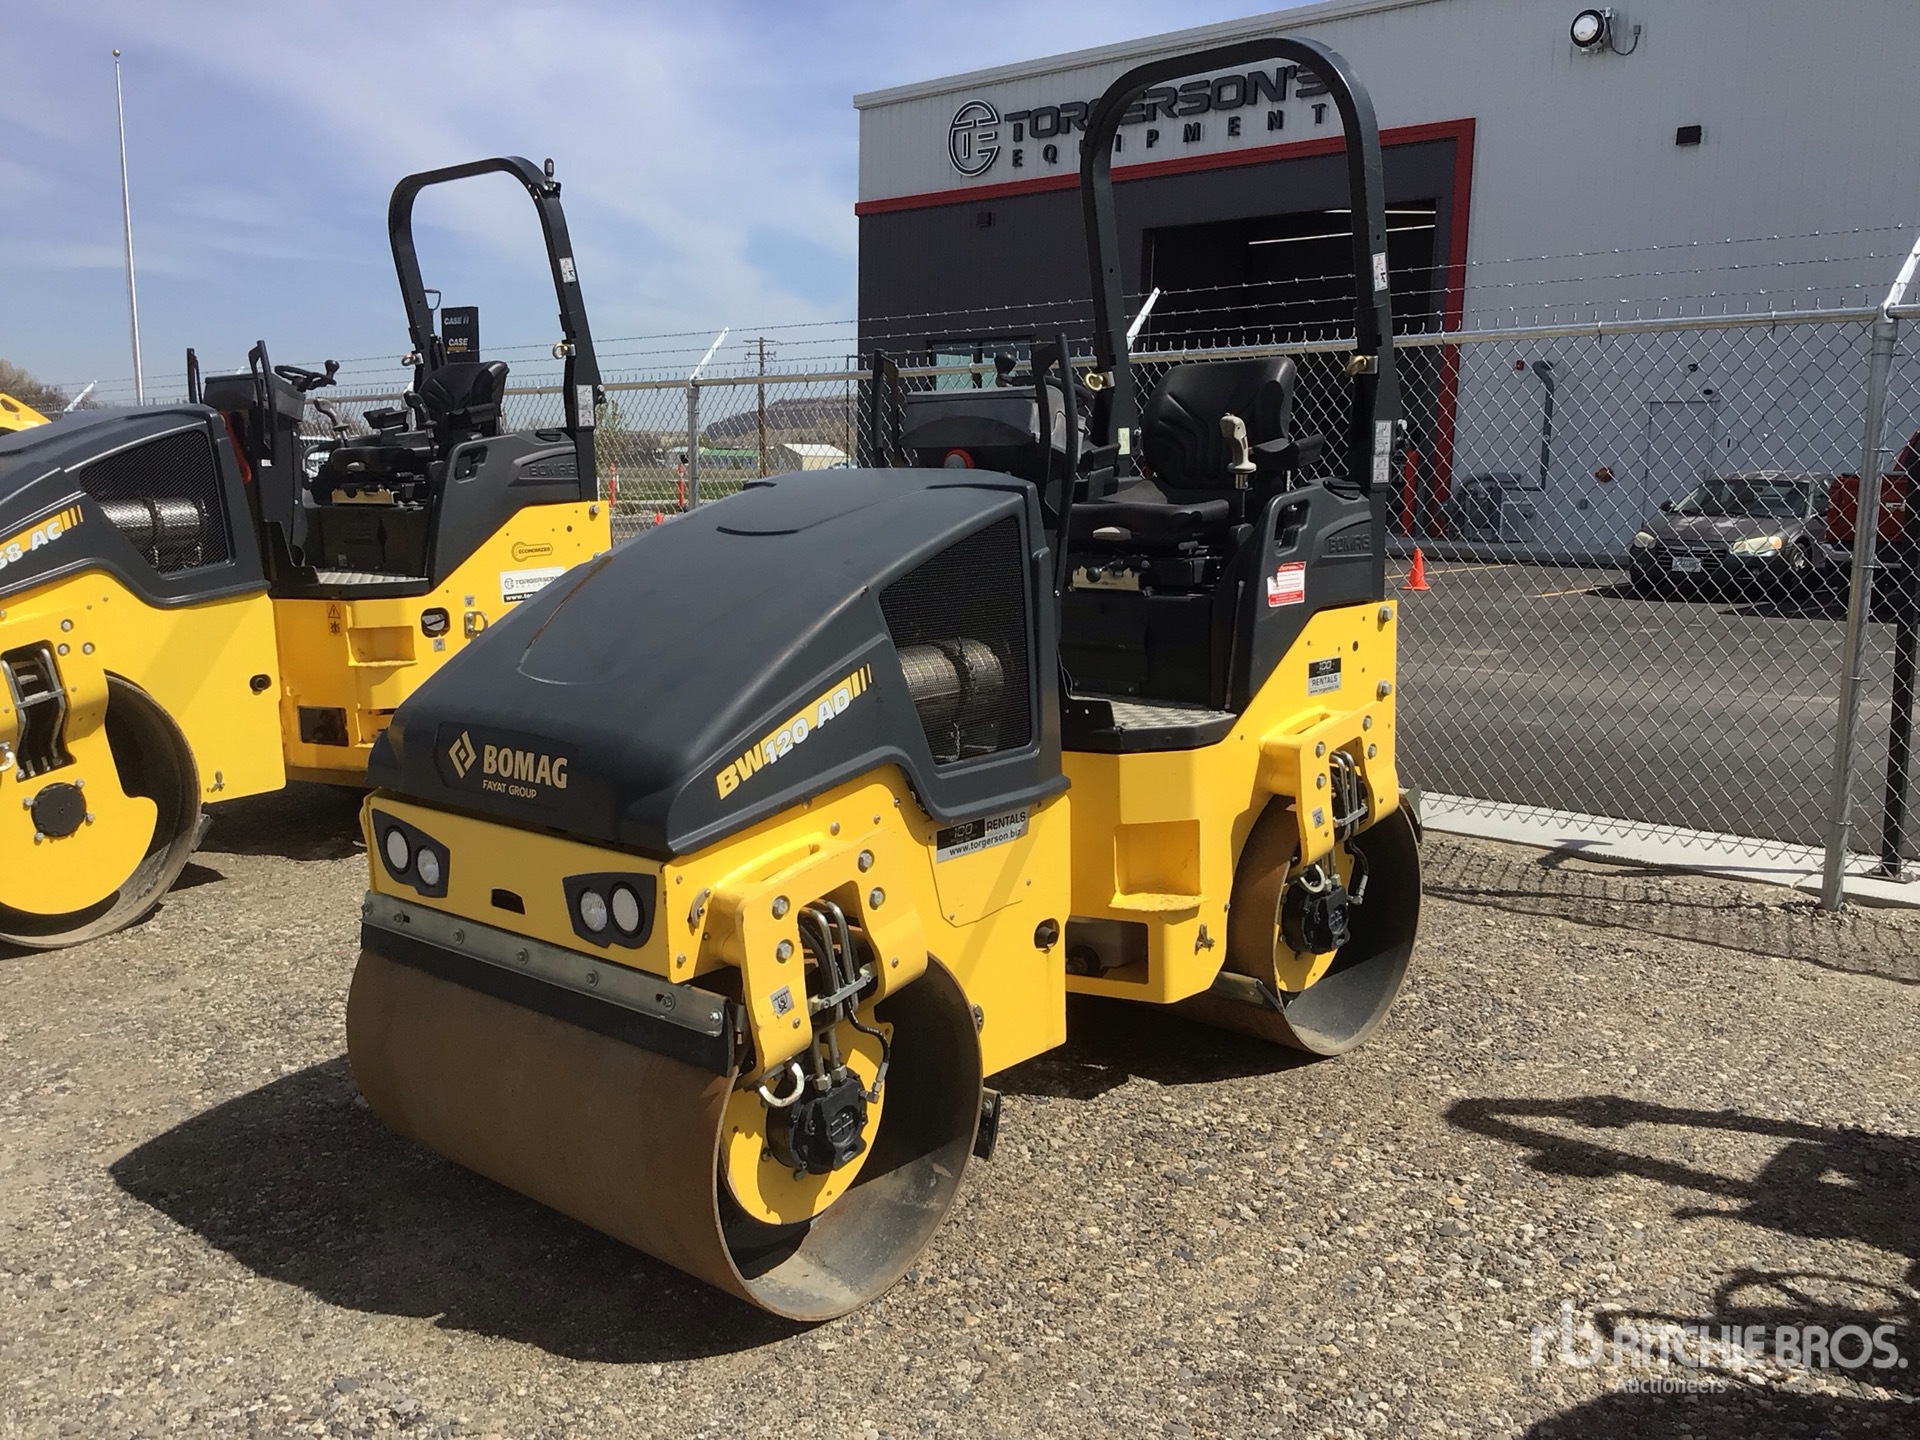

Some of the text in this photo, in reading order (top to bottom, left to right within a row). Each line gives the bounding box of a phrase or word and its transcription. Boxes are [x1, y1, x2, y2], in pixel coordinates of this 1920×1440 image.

[1004, 65, 1331, 142] TORERSON'S
[1012, 103, 1327, 168] EQIPMENT
[444, 316, 462, 325] CASE
[448, 338, 468, 346] CASE
[31, 521, 62, 551] AC
[1312, 674, 1338, 687] RENTALS
[817, 687, 851, 729] AD
[483, 744, 568, 789] BOMAG
[482, 779, 537, 799] FAYAT GROUP
[986, 811, 1026, 831] RENTALS
[949, 828, 1021, 856] www.torgerson.biz
